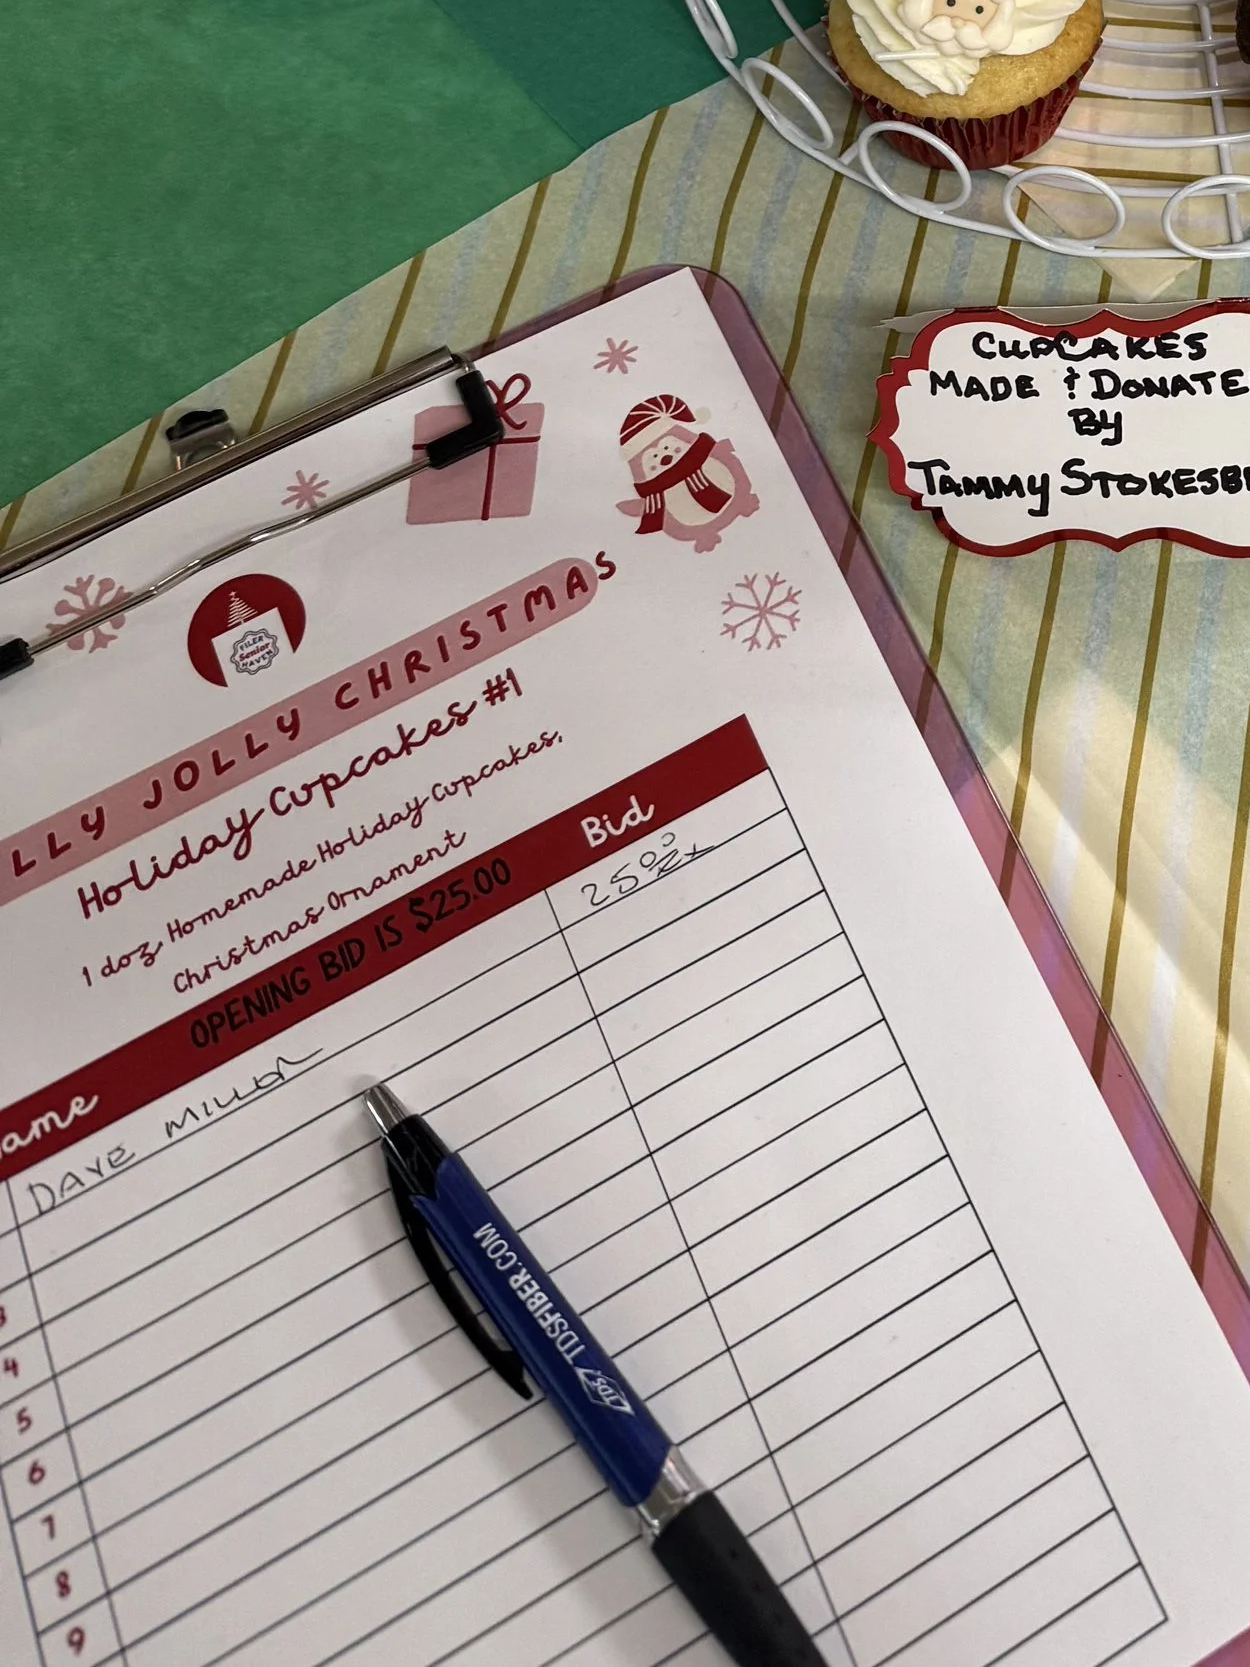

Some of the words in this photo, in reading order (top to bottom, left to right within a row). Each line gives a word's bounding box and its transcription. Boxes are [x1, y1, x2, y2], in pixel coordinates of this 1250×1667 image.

[972, 331, 1209, 362] CUPCAKES
[929, 370, 1040, 401] MADE
[239, 635, 264, 651] FILER
[239, 642, 271, 662] Senior
[241, 649, 273, 668] HAVEN
[11, 805, 106, 877] LLY
[142, 708, 301, 809] JOLLY
[334, 551, 617, 710] CHRISTMAS
[77, 807, 265, 919] Holiday
[269, 699, 477, 809] Cupcakes
[482, 667, 523, 706] #1
[166, 857, 317, 942] Homemade
[317, 796, 429, 862] Holiday
[174, 906, 325, 993] Christmas
[328, 830, 467, 910] Ornament
[189, 967, 311, 1049] OPENING
[318, 938, 367, 983] BID
[374, 920, 403, 952] IS
[408, 857, 512, 933] $25.00
[0, 1094, 99, 1160] ame
[580, 795, 655, 848] Bid
[473, 1222, 586, 1364] TDSFIBER.COM
[3, 1357, 18, 1377] 4
[16, 1407, 32, 1433] 5
[28, 1460, 46, 1485] 6
[41, 1514, 55, 1539] 7
[55, 1570, 71, 1599] 8
[67, 1626, 86, 1656] 9
